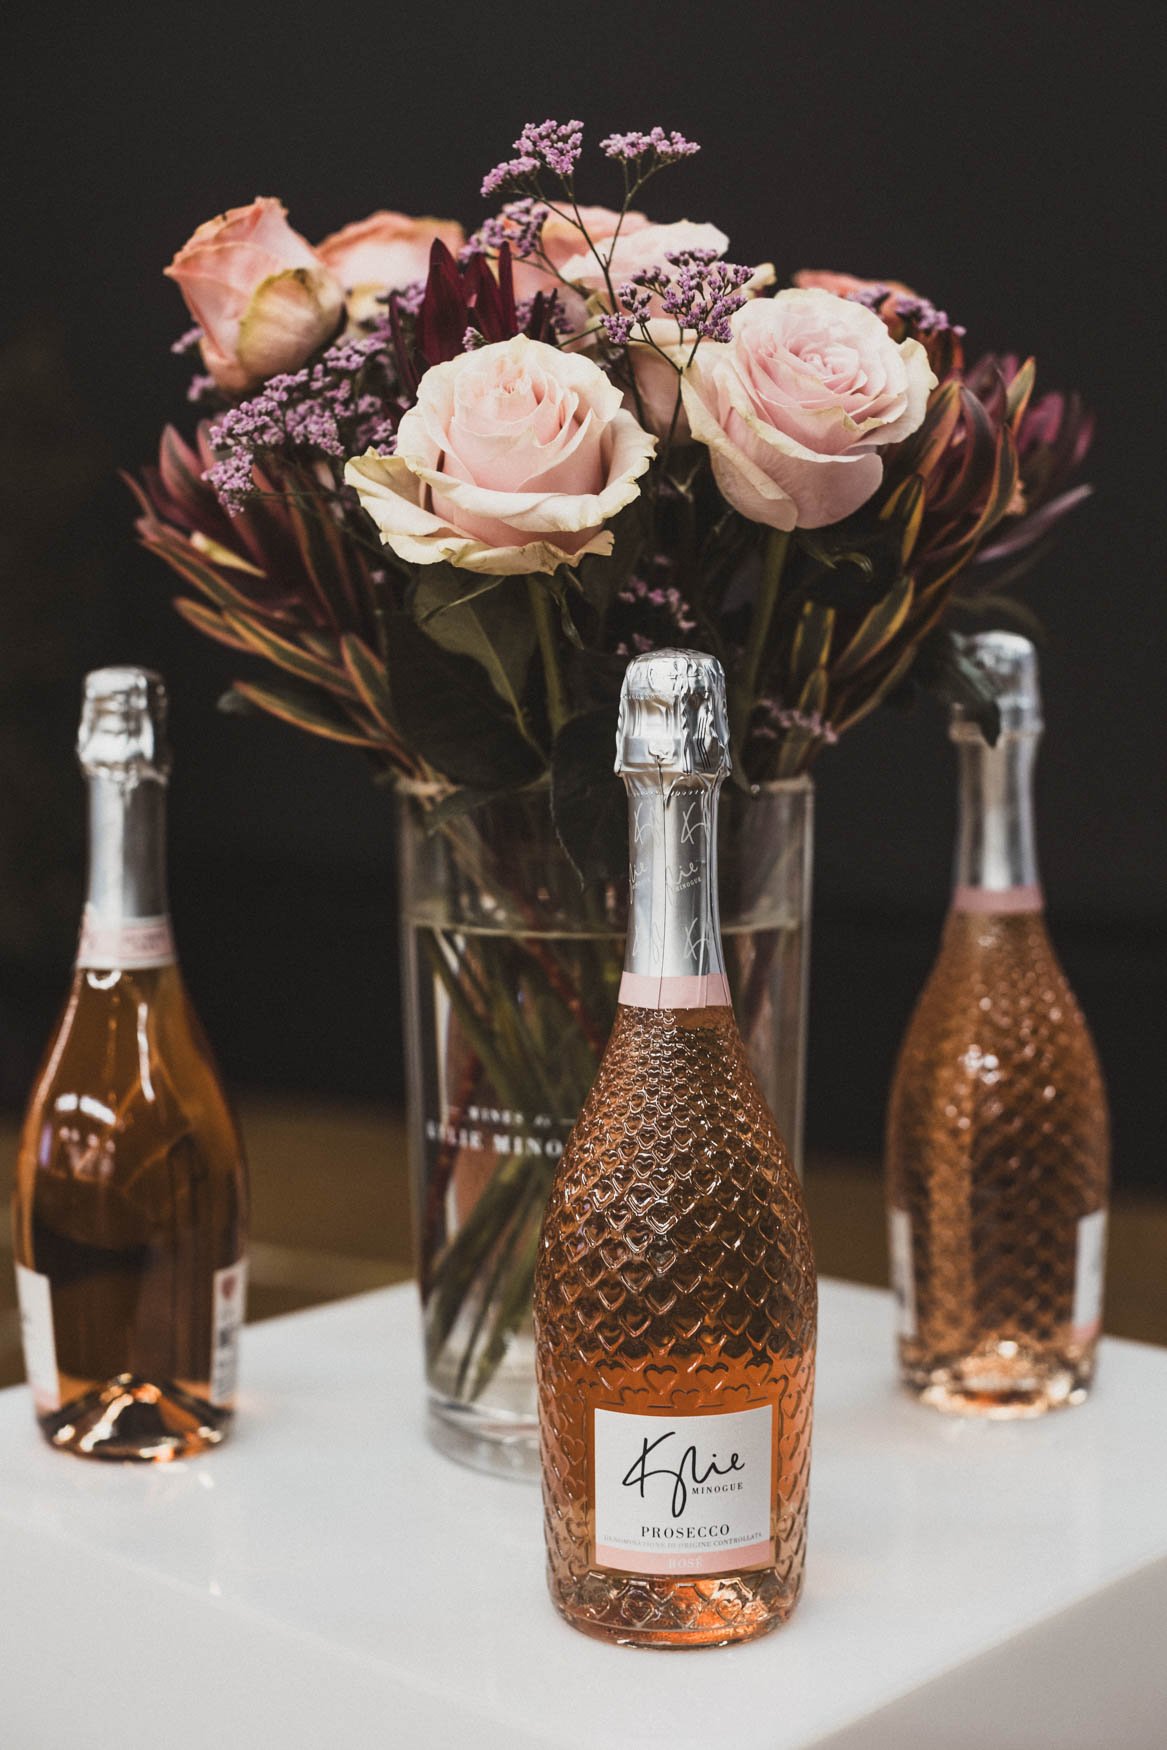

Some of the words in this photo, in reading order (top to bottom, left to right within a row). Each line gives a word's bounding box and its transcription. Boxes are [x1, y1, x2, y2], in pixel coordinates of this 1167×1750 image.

[493, 1134, 563, 1157] MINO
[622, 1431, 745, 1518] Kylie
[691, 1482, 744, 1495] MINOGUE
[641, 1524, 730, 1539] PROSECCO
